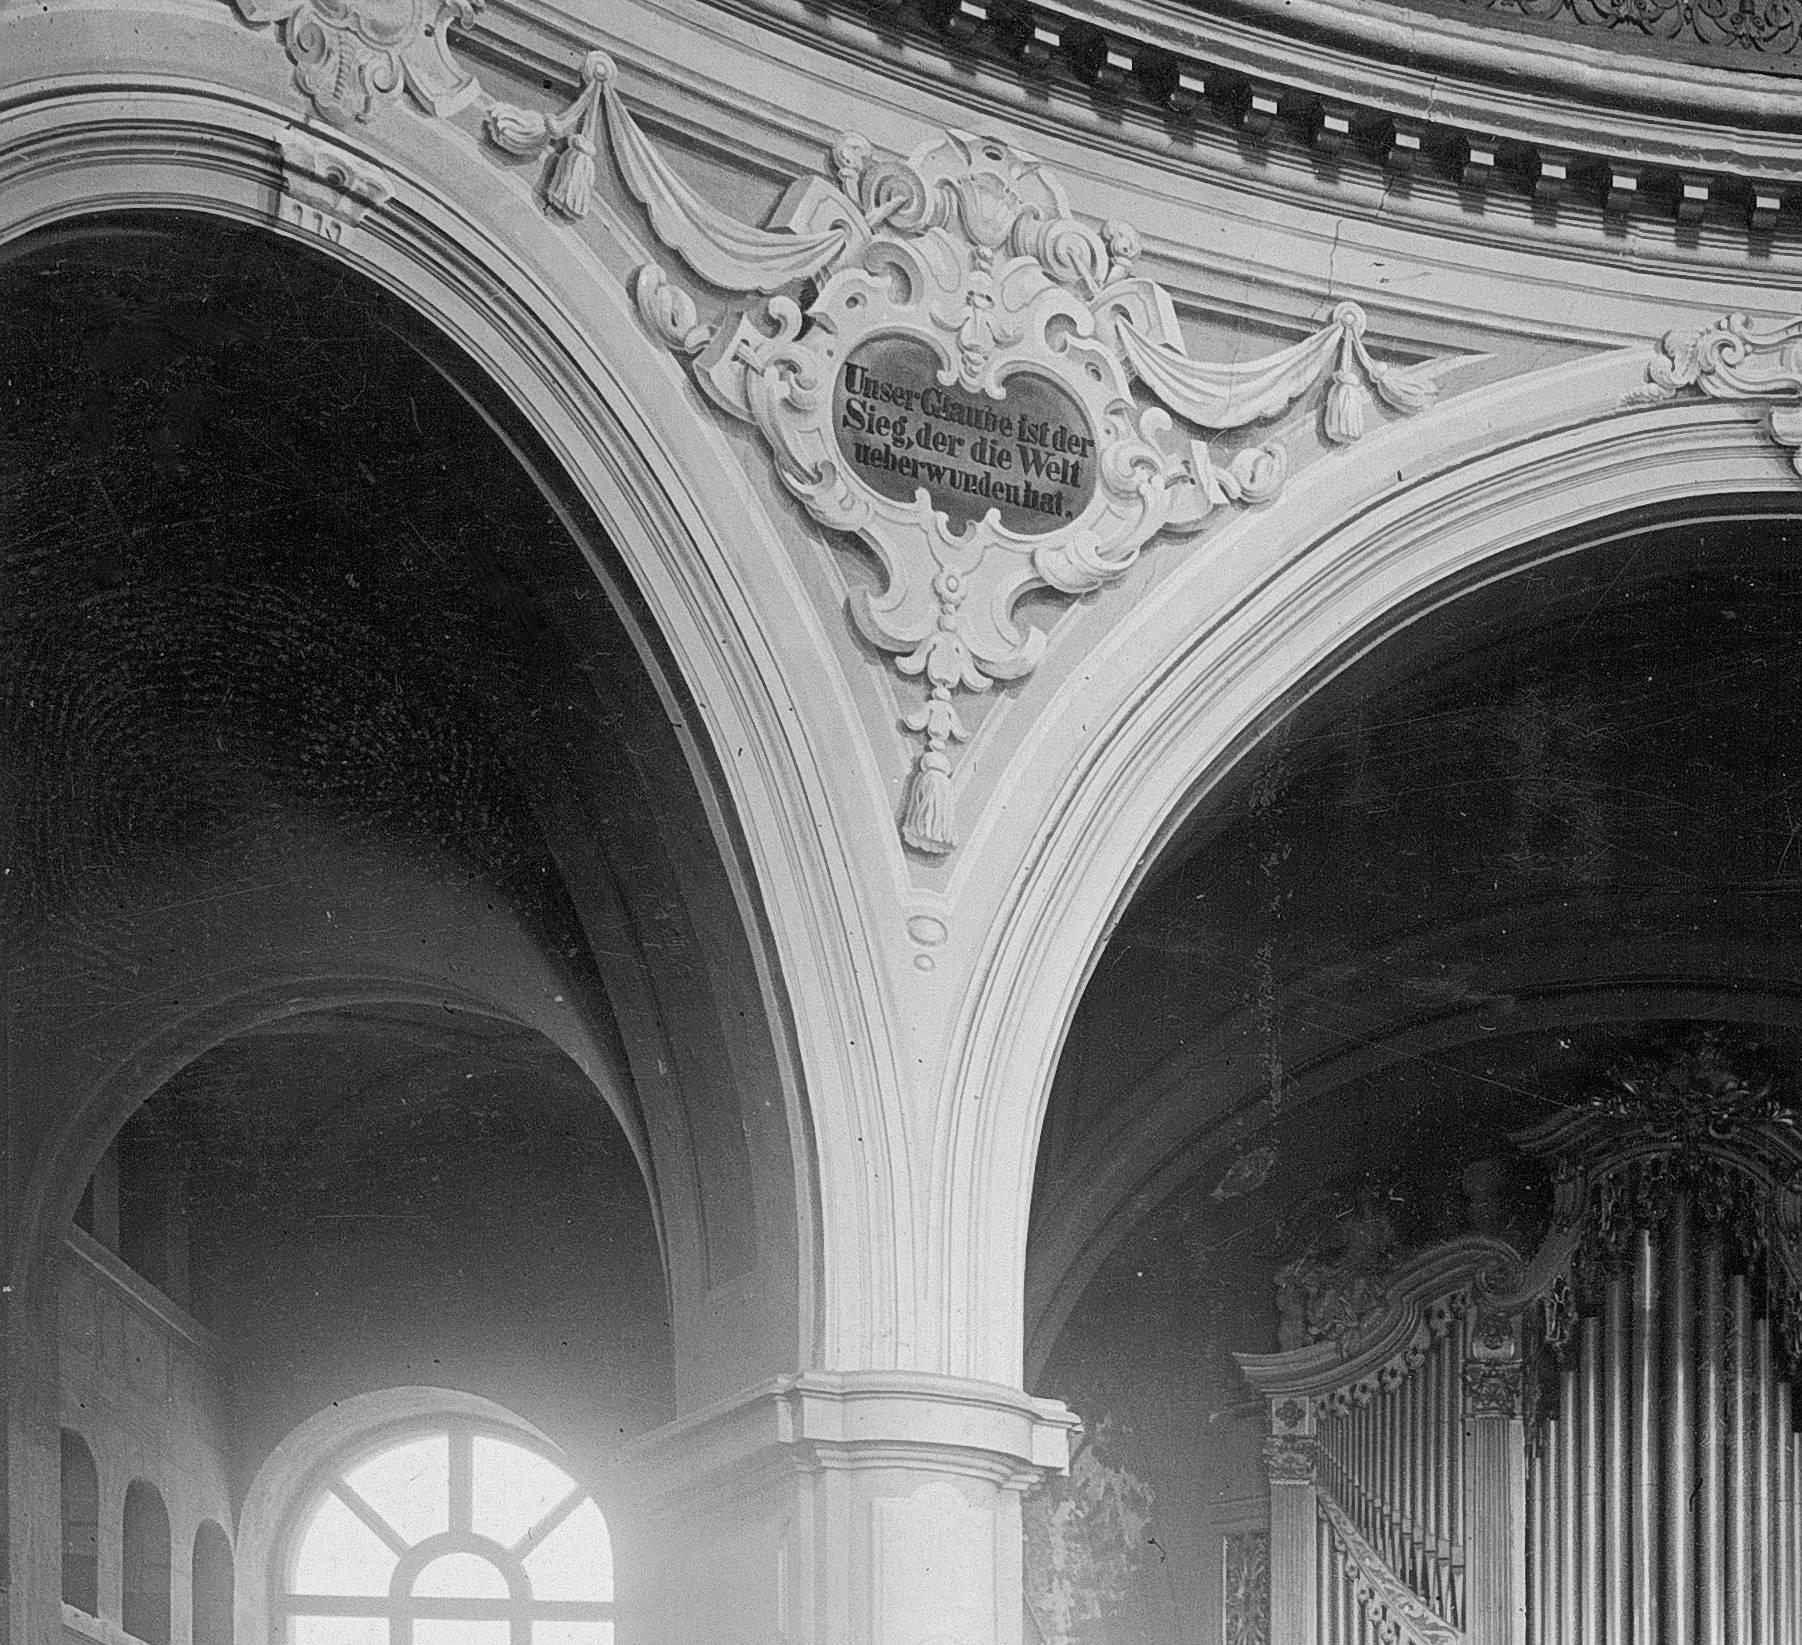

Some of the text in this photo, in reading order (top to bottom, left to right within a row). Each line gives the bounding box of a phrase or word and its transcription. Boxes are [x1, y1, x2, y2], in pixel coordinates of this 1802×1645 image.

[842, 398, 1081, 488] Sieg, der die Welt
[845, 361, 1095, 458] Unser Glaube ist der
[853, 441, 1021, 506] ueberwunden
